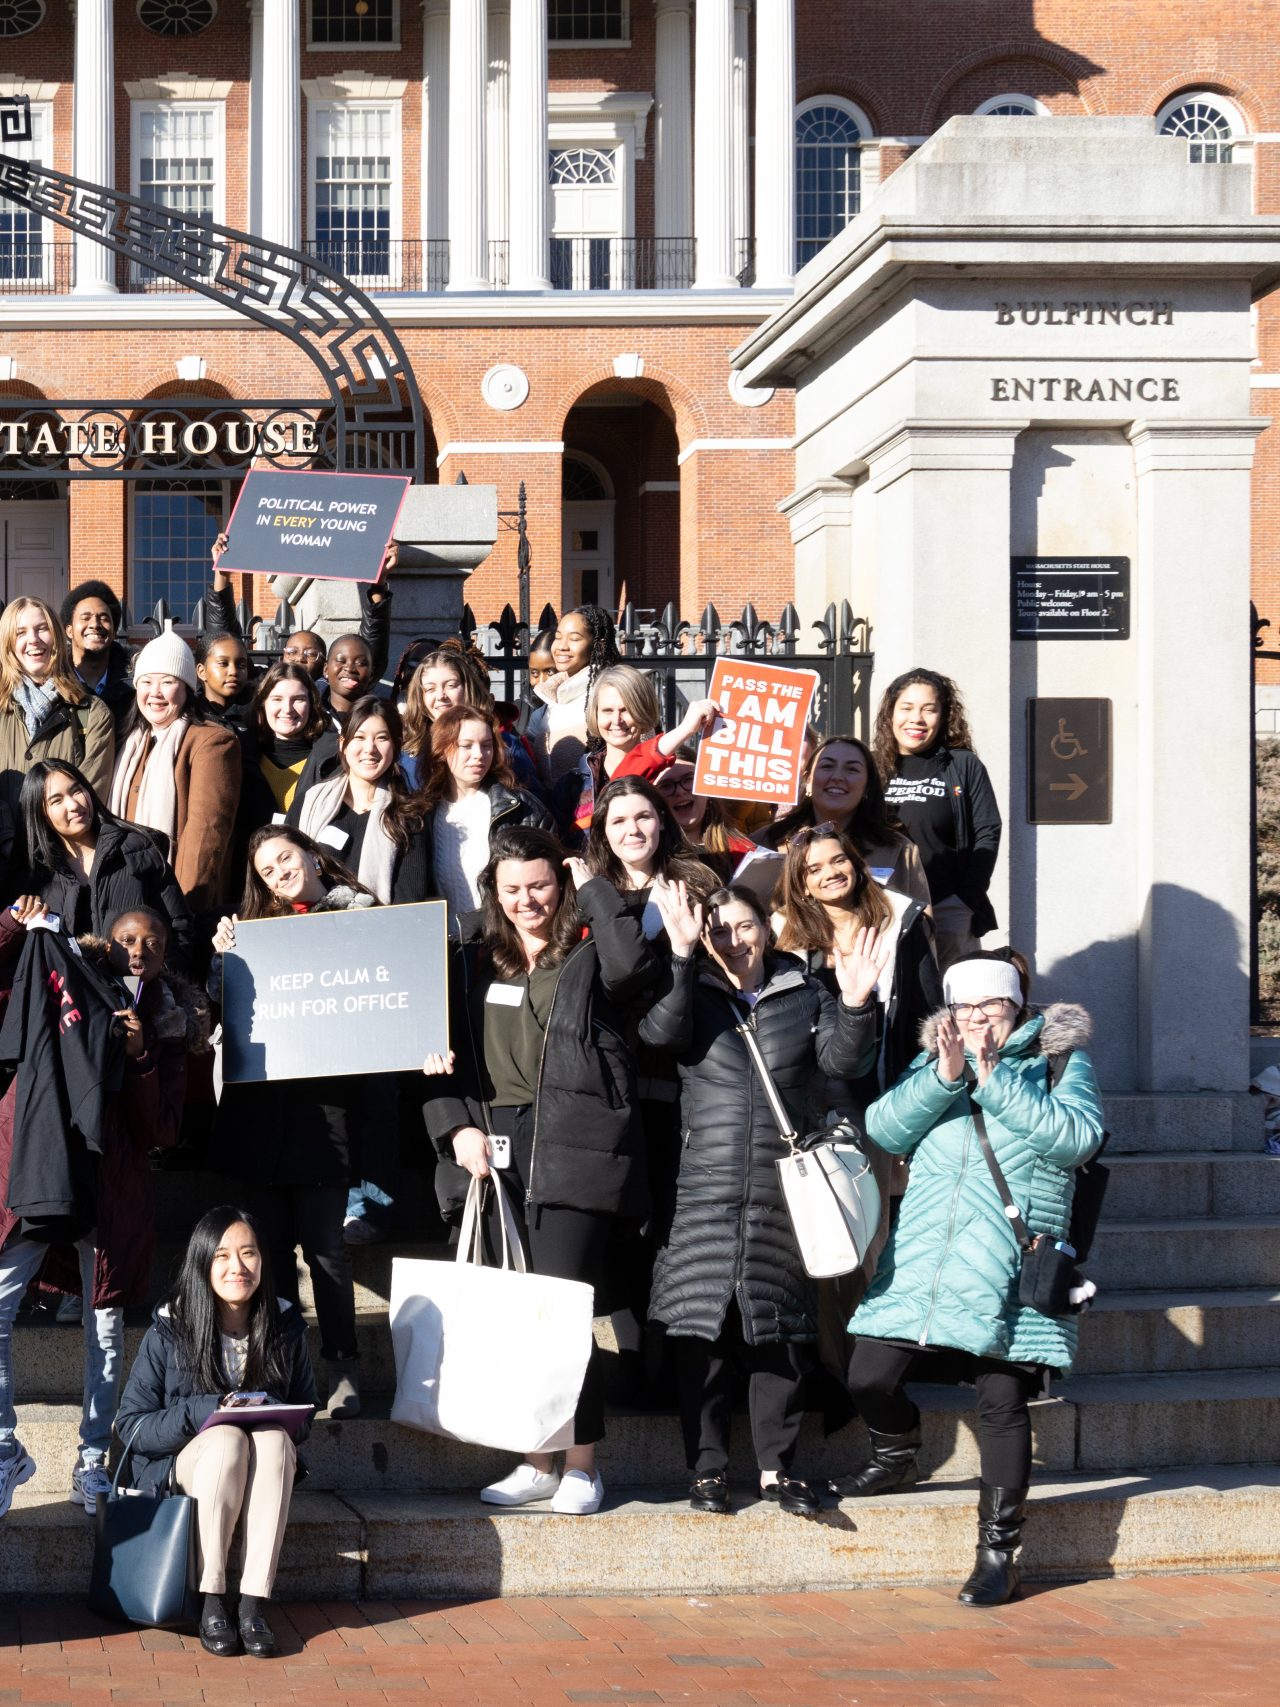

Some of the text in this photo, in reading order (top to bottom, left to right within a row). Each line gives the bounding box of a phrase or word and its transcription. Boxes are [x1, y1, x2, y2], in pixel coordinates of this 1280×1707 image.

[993, 301, 1175, 325] BULFINCH
[990, 378, 1180, 401] ENTRANCE
[140, 422, 320, 456] HOUSE
[258, 498, 378, 515] POLITICAL POWER
[256, 515, 367, 532] IN EVERY YOUNG
[280, 533, 332, 547] WOMAN
[1017, 590, 1047, 599] Monday
[1111, 591, 1124, 599] pm
[1017, 599, 1040, 607] Public
[721, 674, 804, 699] PASS THE
[720, 690, 798, 728] I AM
[710, 718, 792, 757] BILL
[705, 746, 793, 781] THIS
[703, 773, 790, 795] SESSION
[885, 785, 946, 797] PERIOD
[270, 965, 390, 992] KEEP CALM &
[259, 992, 409, 1020] RUN FOR OFFICE
